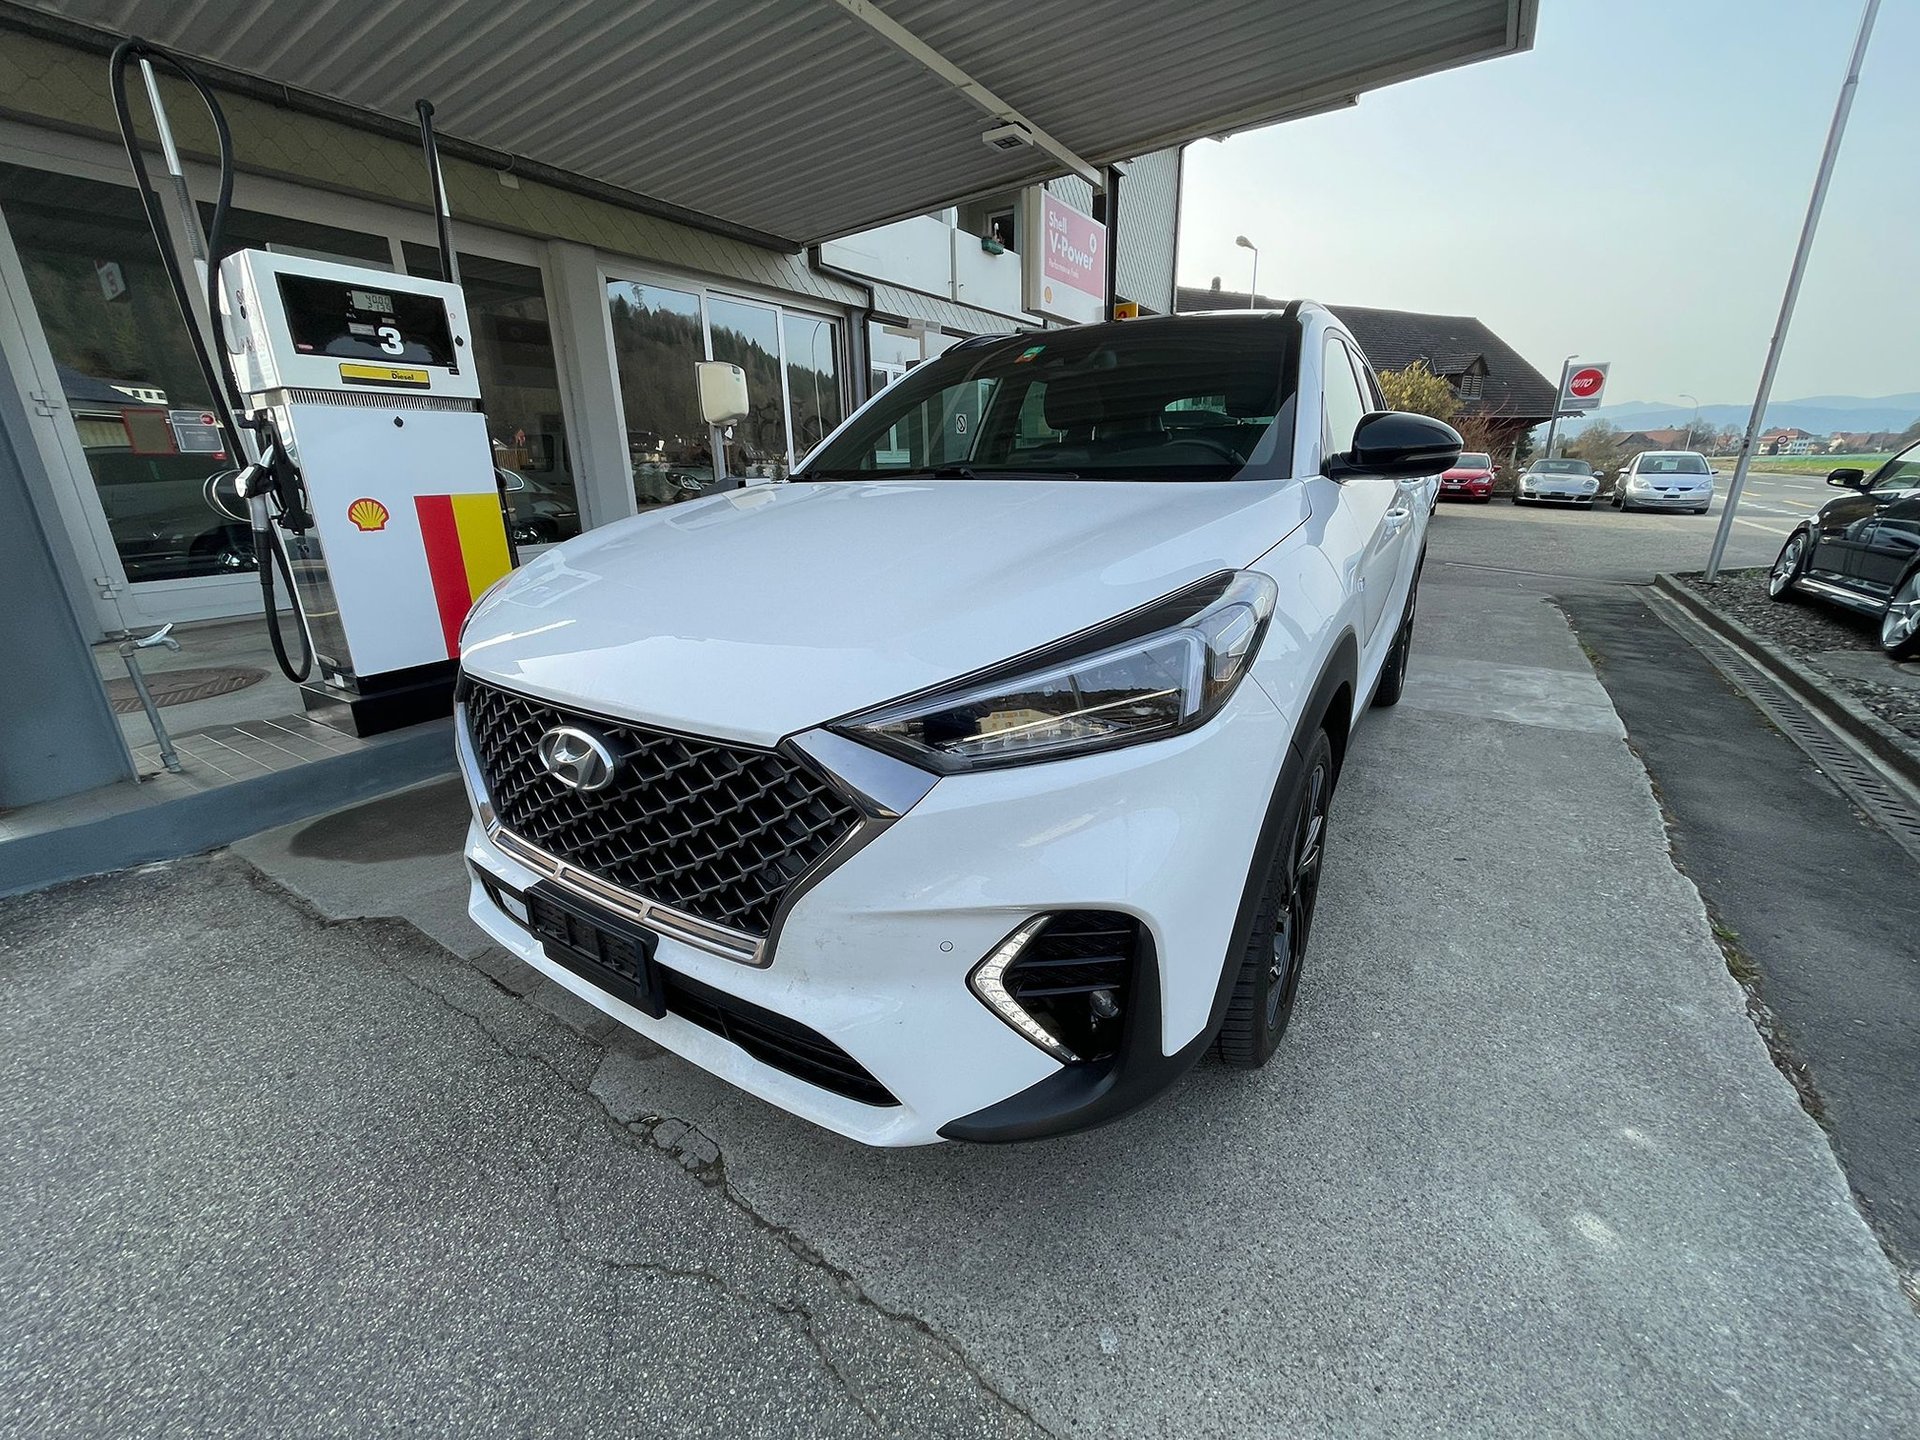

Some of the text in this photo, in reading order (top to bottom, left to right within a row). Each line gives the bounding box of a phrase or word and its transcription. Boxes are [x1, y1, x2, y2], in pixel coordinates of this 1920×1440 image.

[1048, 210, 1068, 235] Shell
[1049, 230, 1094, 271] V-Power
[378, 326, 404, 355] 3
[391, 372, 415, 381] Diesel
